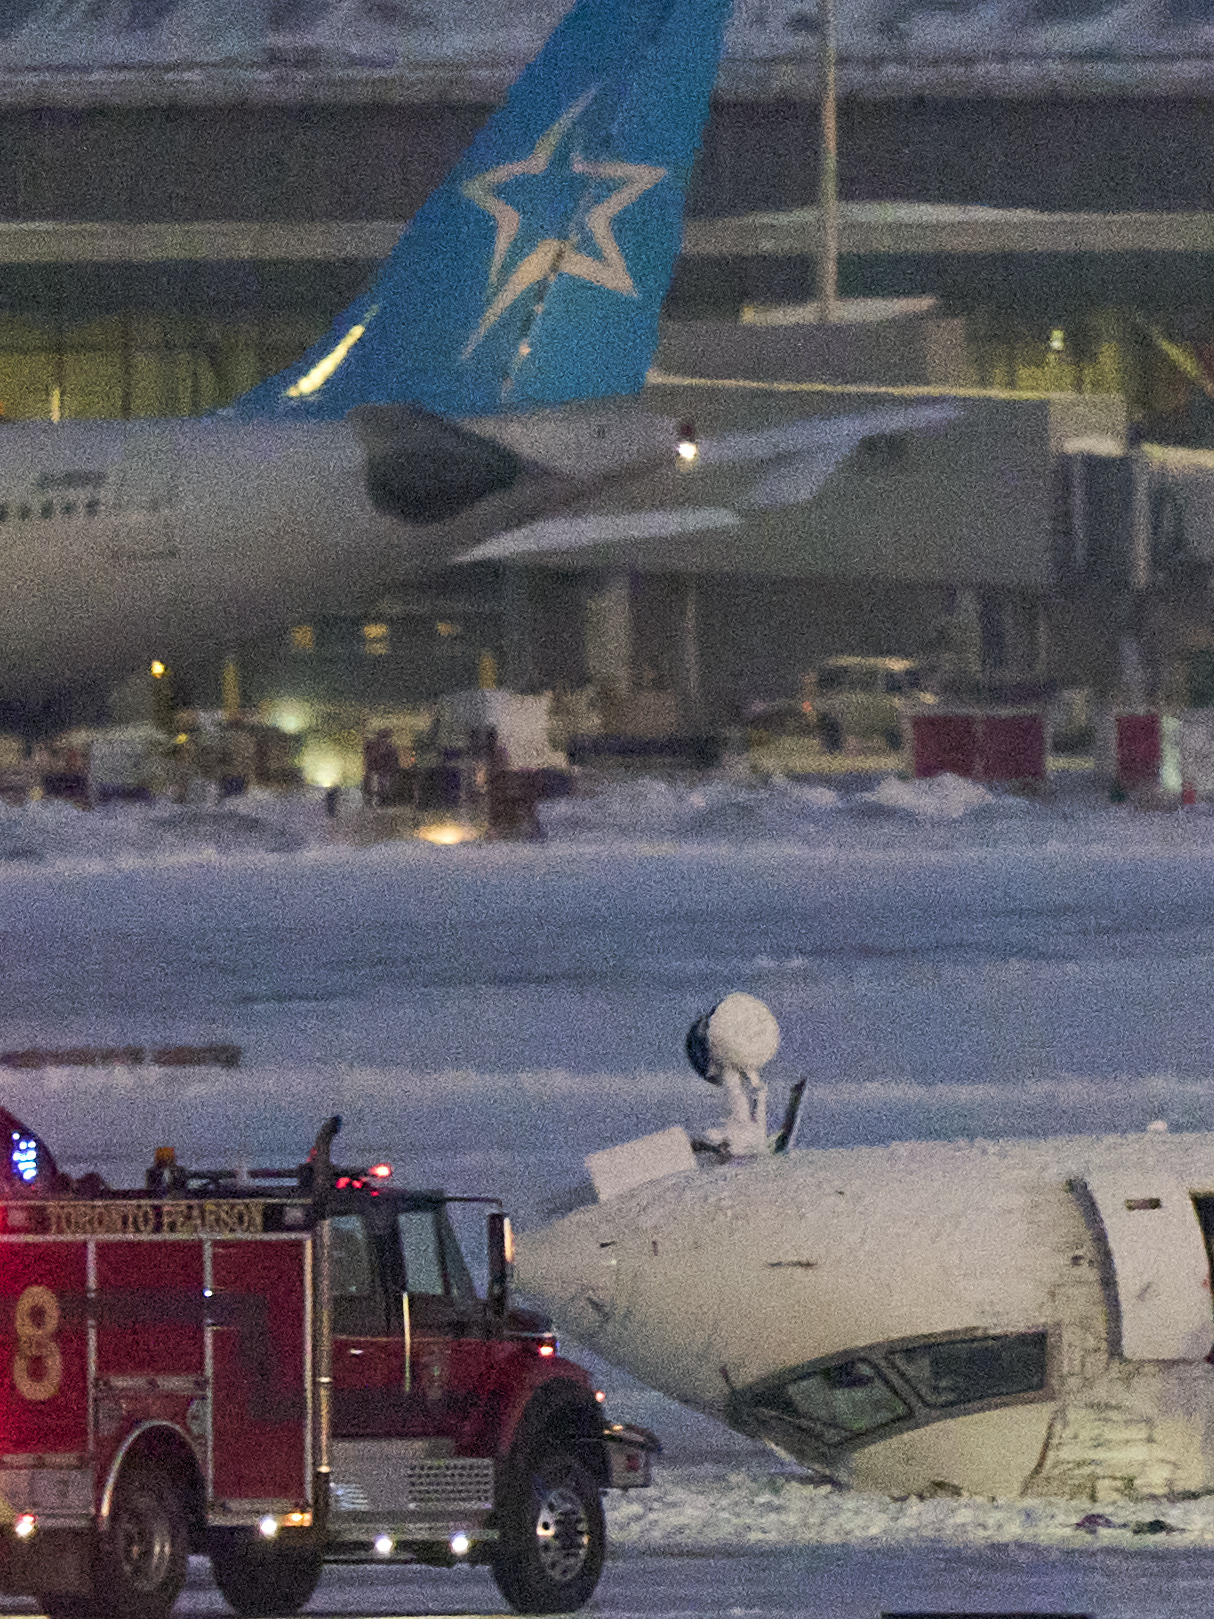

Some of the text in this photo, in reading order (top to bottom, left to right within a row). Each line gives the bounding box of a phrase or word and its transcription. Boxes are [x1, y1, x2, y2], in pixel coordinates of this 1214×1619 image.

[46, 1203, 264, 1233] TORONTO PEARSON
[13, 1285, 63, 1400] 8
